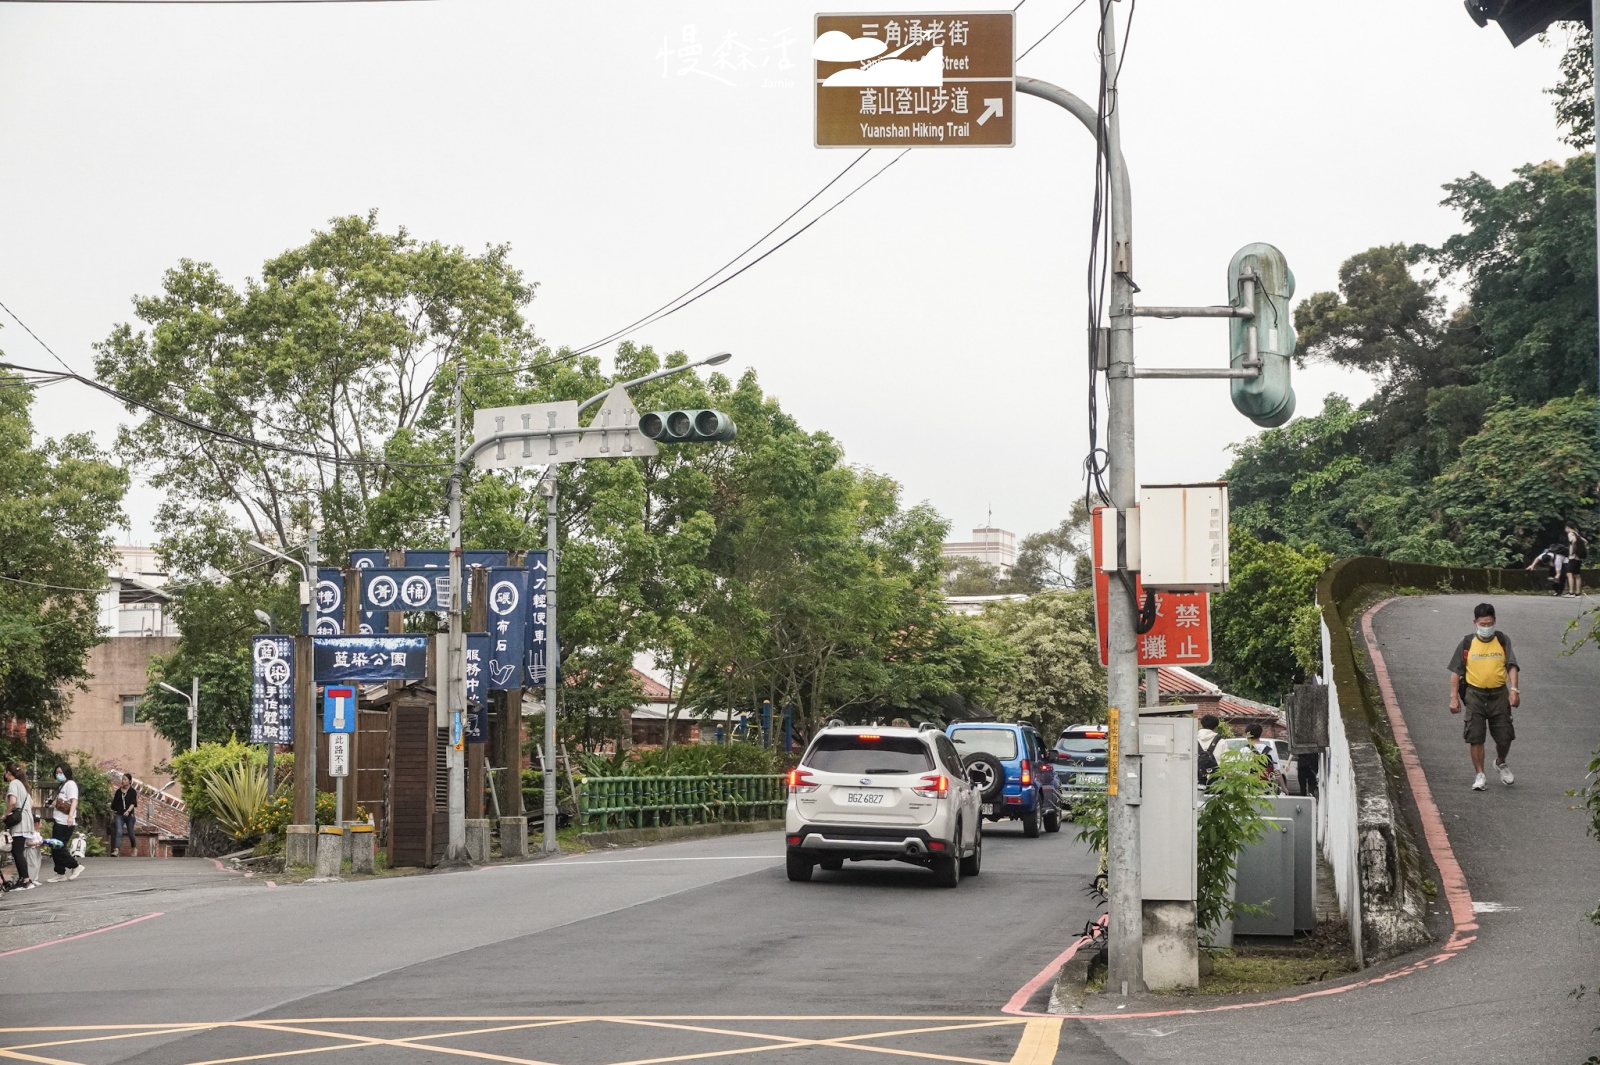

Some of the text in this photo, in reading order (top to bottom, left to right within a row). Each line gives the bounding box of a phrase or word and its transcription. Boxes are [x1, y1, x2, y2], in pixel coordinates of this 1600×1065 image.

[861, 19, 969, 47] 三角湧老街
[859, 87, 969, 115] 鳶山登山步道
[860, 121, 970, 142] Yuanshan Hiking Trail
[332, 651, 407, 669] 藍染公園
[334, 735, 344, 775] 此路不通
